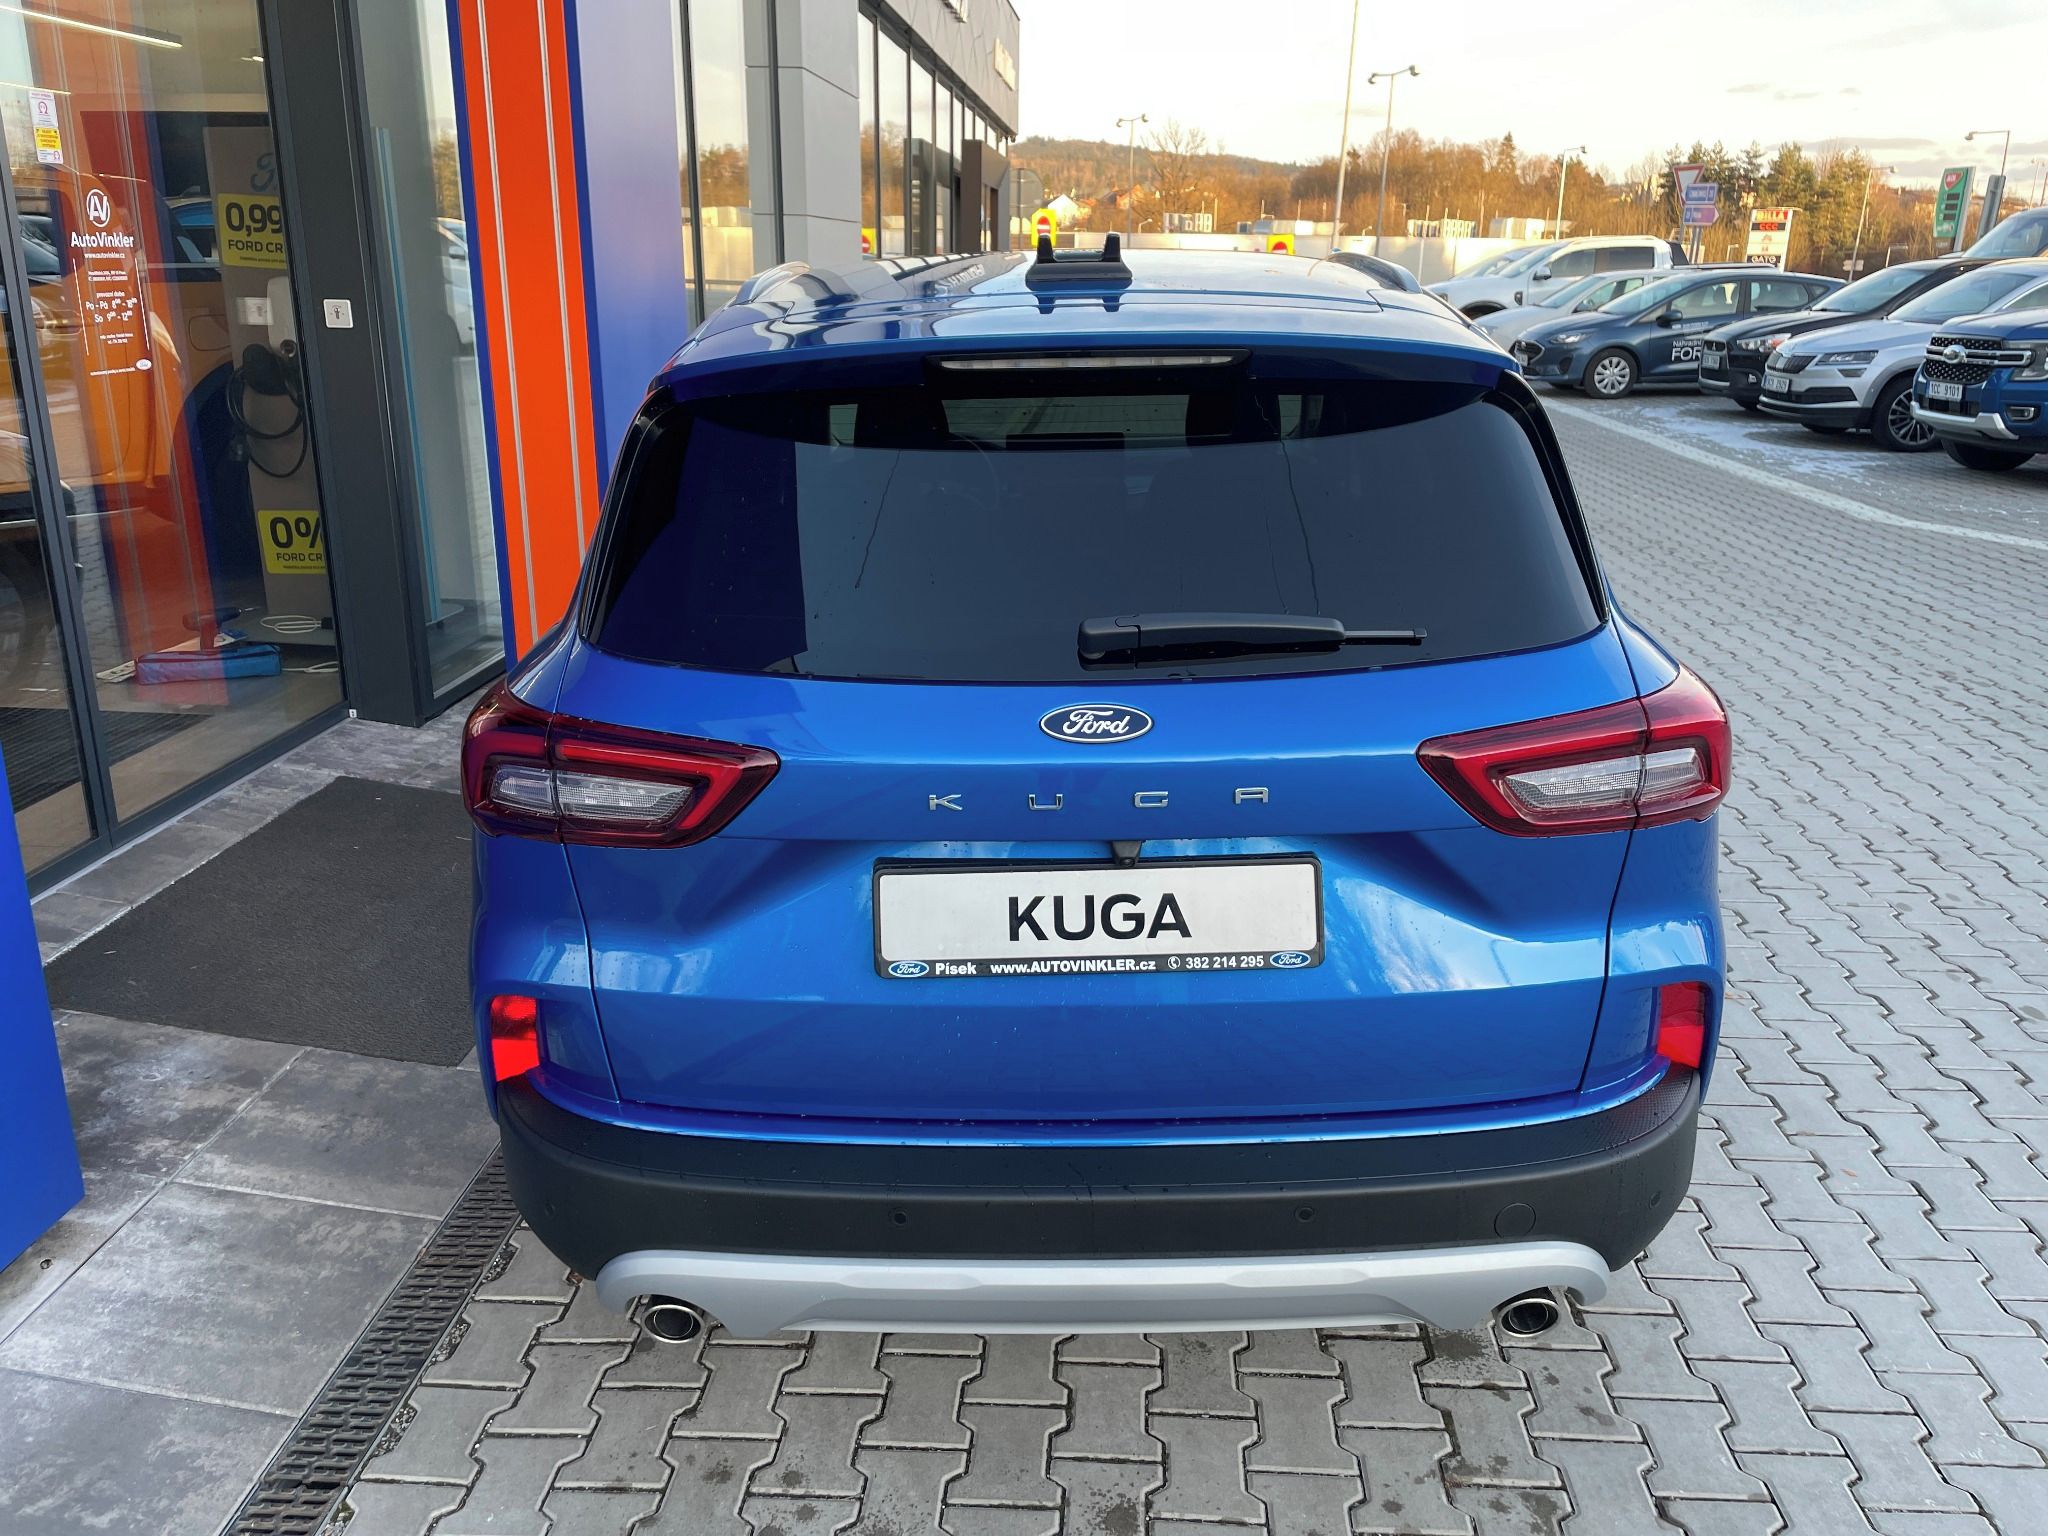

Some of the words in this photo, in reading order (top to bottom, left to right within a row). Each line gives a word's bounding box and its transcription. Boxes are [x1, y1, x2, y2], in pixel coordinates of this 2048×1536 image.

[1756, 210, 1785, 221] BILLA
[1760, 223, 1778, 231] CCC
[71, 231, 134, 248] AutoVinkler
[228, 239, 263, 252] FORD
[85, 301, 94, 310] Po
[94, 314, 104, 323] So
[269, 516, 321, 549] 0%
[276, 552, 305, 562] FORD
[1062, 709, 1131, 734] Ford
[928, 786, 1269, 811] KUGA
[1008, 892, 1193, 942] KUGA
[935, 961, 977, 975] Písek
[990, 957, 1157, 974] www.AUTOVINKLER.cz
[1185, 957, 1210, 969] 382
[1212, 956, 1237, 968] 214
[1239, 955, 1264, 967] 295
[1277, 953, 1303, 965] Ford
[896, 963, 921, 974] Ford
